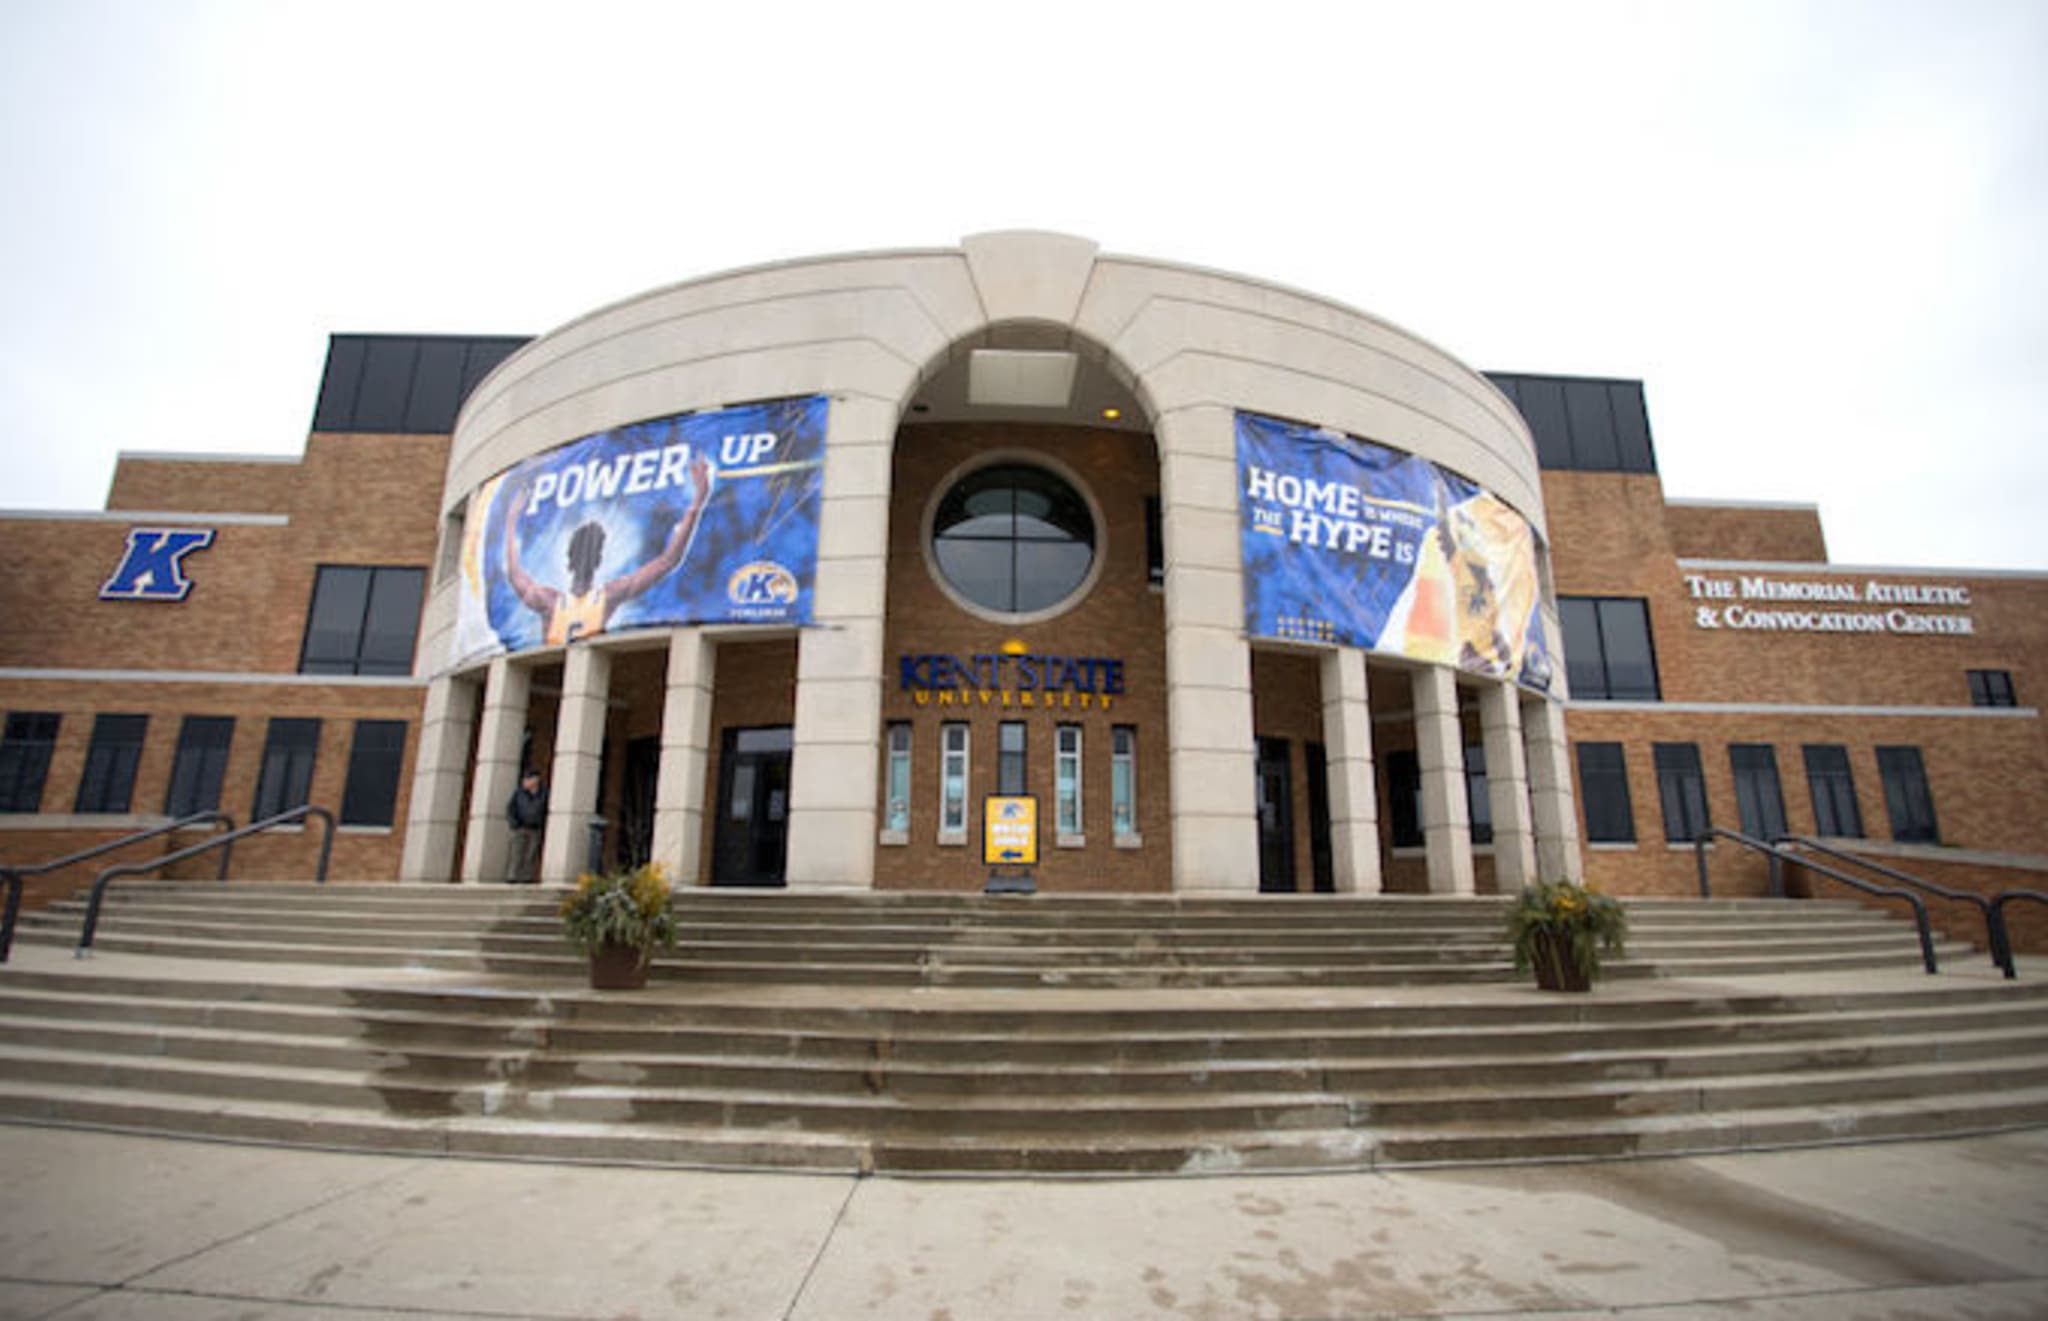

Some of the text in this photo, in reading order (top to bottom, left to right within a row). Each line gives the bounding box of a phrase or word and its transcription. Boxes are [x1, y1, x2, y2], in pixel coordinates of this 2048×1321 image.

[527, 432, 778, 513] POWER UP
[1248, 465, 1360, 517] HOME
[1253, 507, 1414, 564] THE HYPE IS
[100, 527, 216, 602] K
[1696, 605, 1721, 629] &
[900, 654, 1124, 694] KENT STATE
[913, 690, 1113, 709] UNIVERSITY
